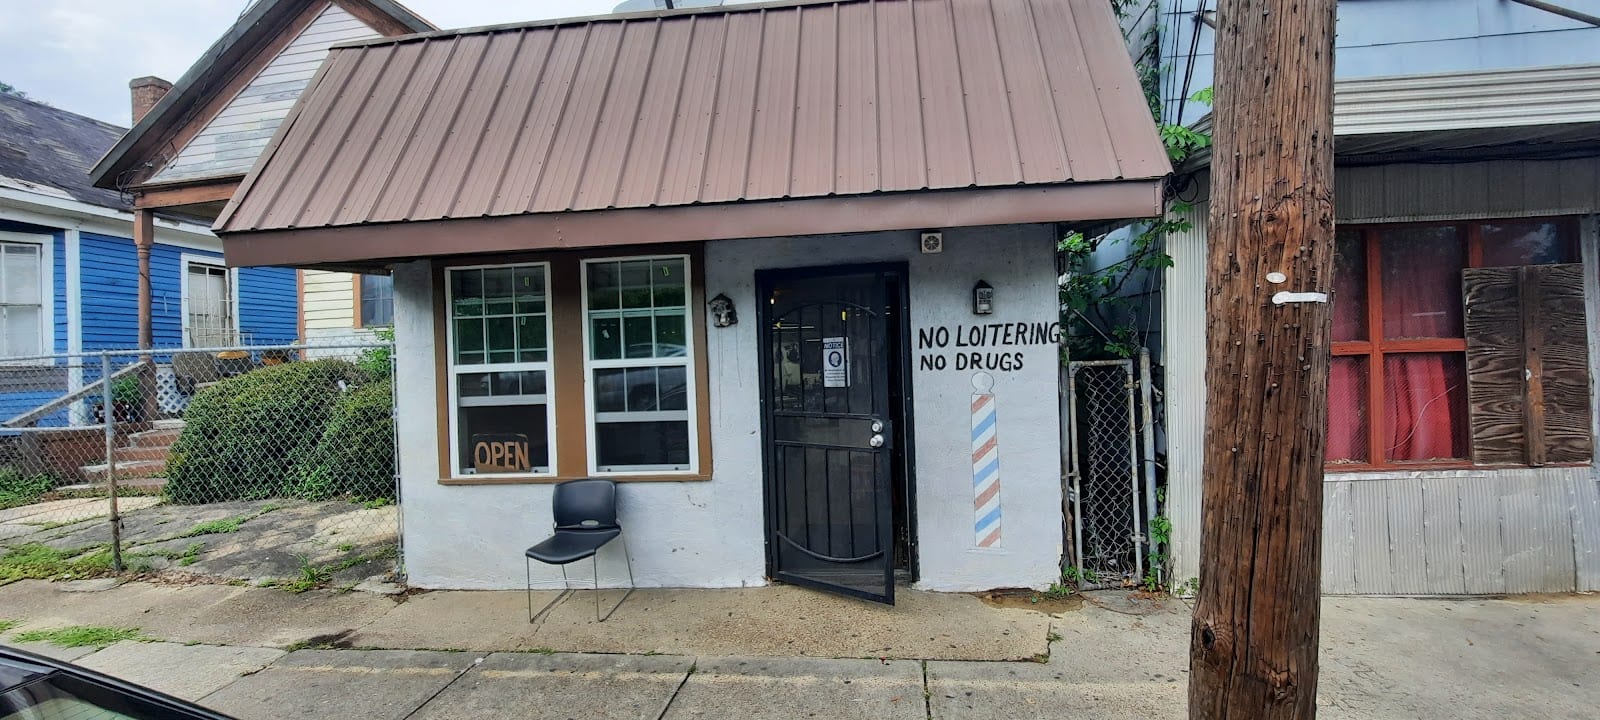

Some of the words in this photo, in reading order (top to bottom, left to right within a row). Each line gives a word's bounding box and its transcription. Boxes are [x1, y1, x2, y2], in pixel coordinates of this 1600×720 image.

[919, 326, 949, 349] NO
[956, 321, 1060, 346] LOITERING
[920, 354, 946, 371] NO
[955, 352, 1024, 372] DRUGS
[474, 441, 530, 472] OPEN
